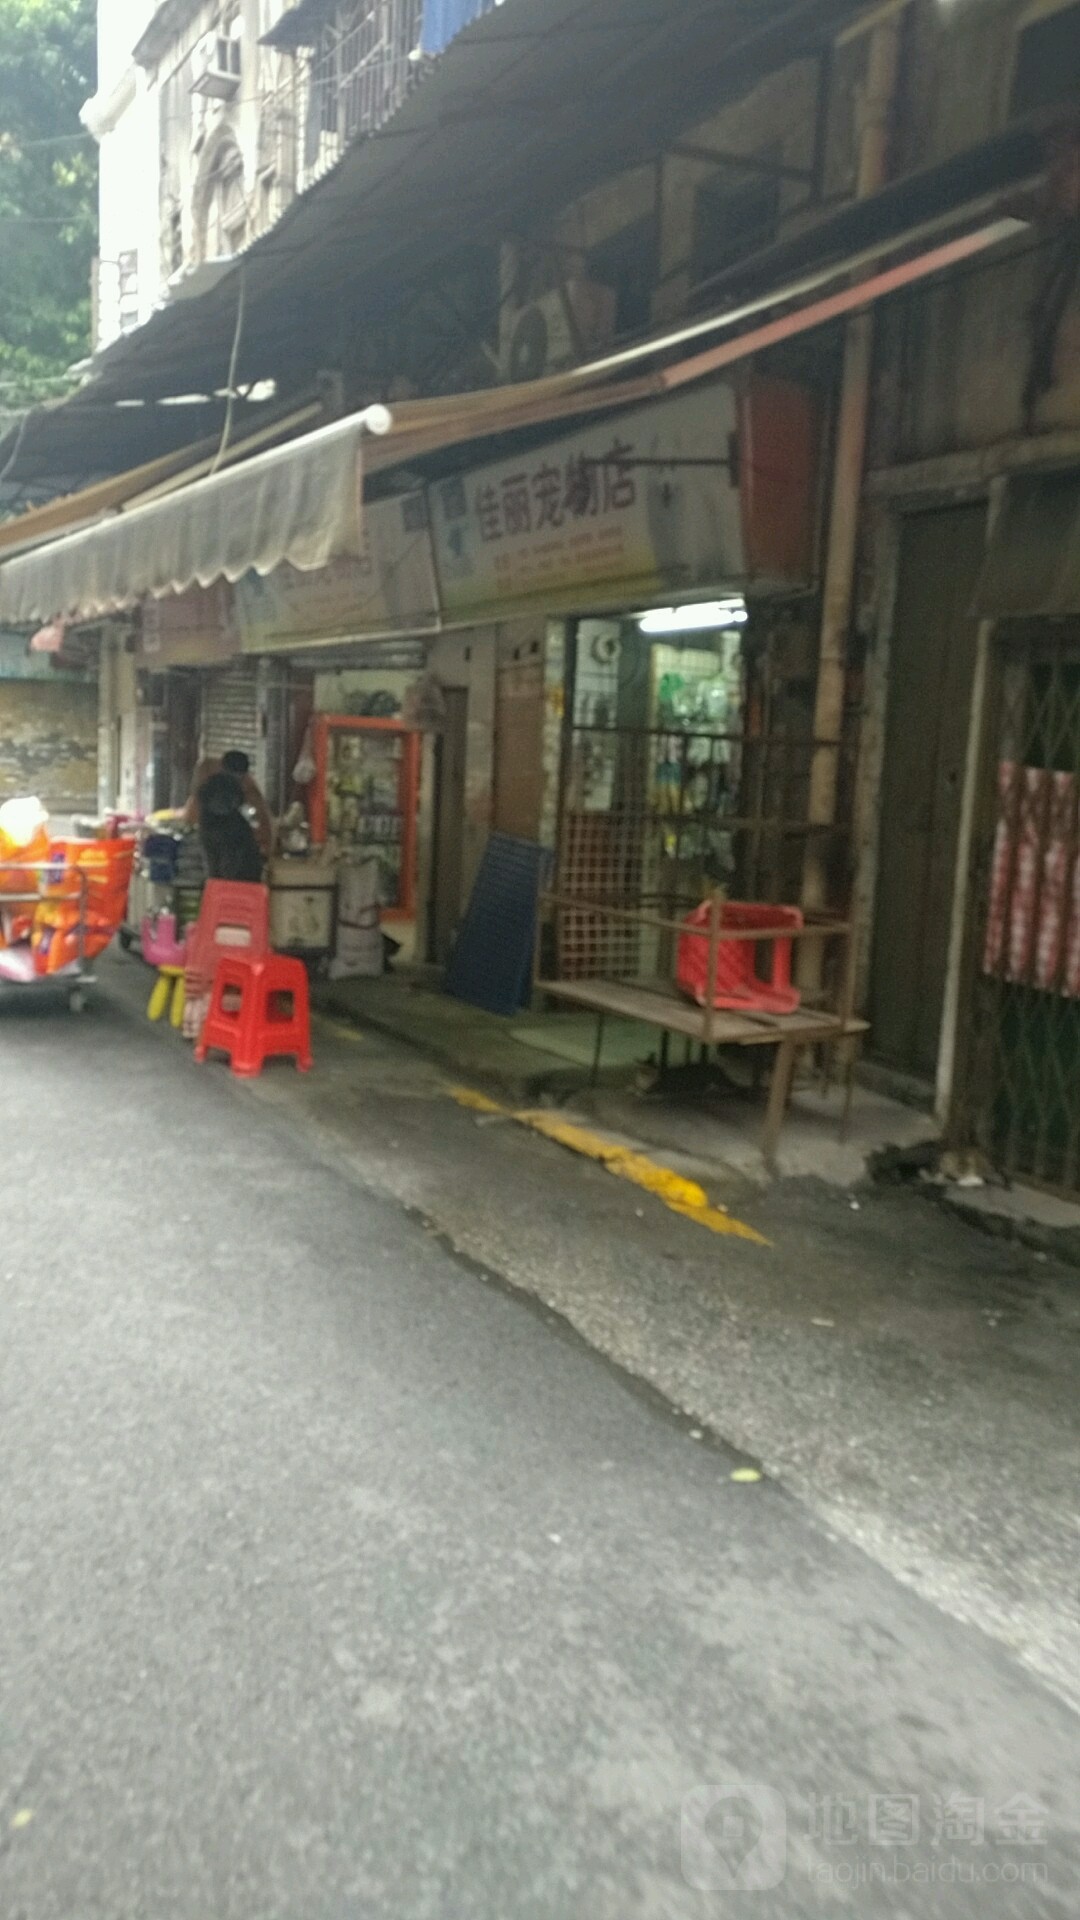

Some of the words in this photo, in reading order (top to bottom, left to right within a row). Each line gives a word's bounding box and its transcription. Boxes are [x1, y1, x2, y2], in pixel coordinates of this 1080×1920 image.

[475, 436, 637, 542] 佳丽宠物店
